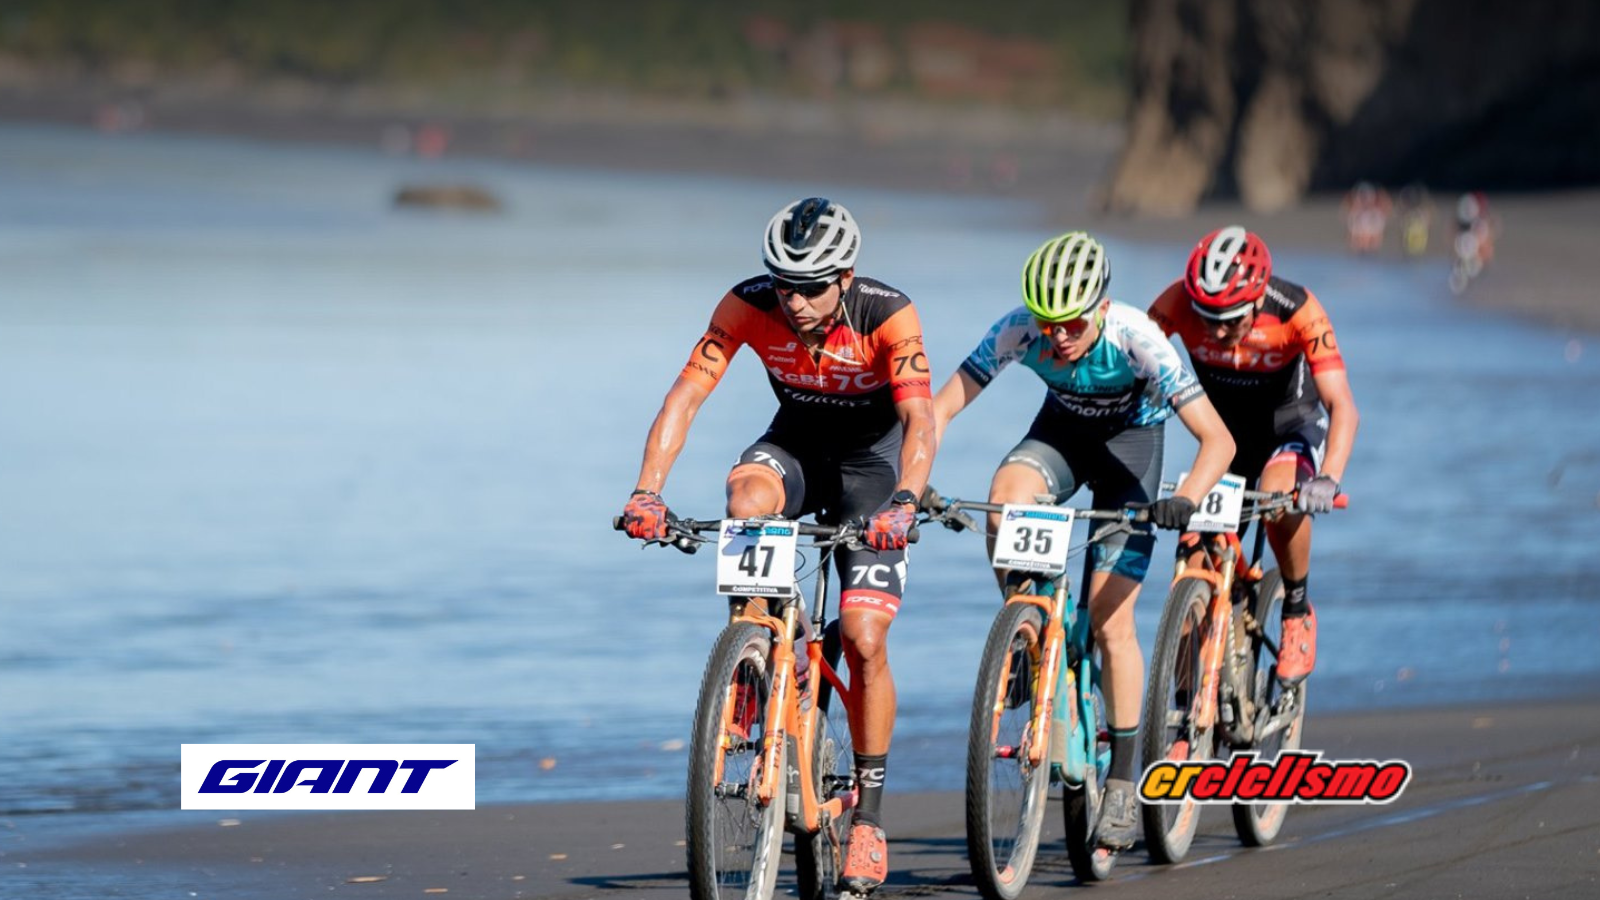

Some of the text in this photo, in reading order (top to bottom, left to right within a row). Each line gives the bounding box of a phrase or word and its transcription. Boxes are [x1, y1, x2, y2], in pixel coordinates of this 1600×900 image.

[893, 351, 930, 376] 7C
[832, 371, 879, 391] 7C
[754, 451, 787, 478] 7C
[1196, 491, 1224, 516] 8
[1013, 526, 1053, 555] 35
[738, 545, 775, 577] 47
[851, 563, 891, 587] 7C
